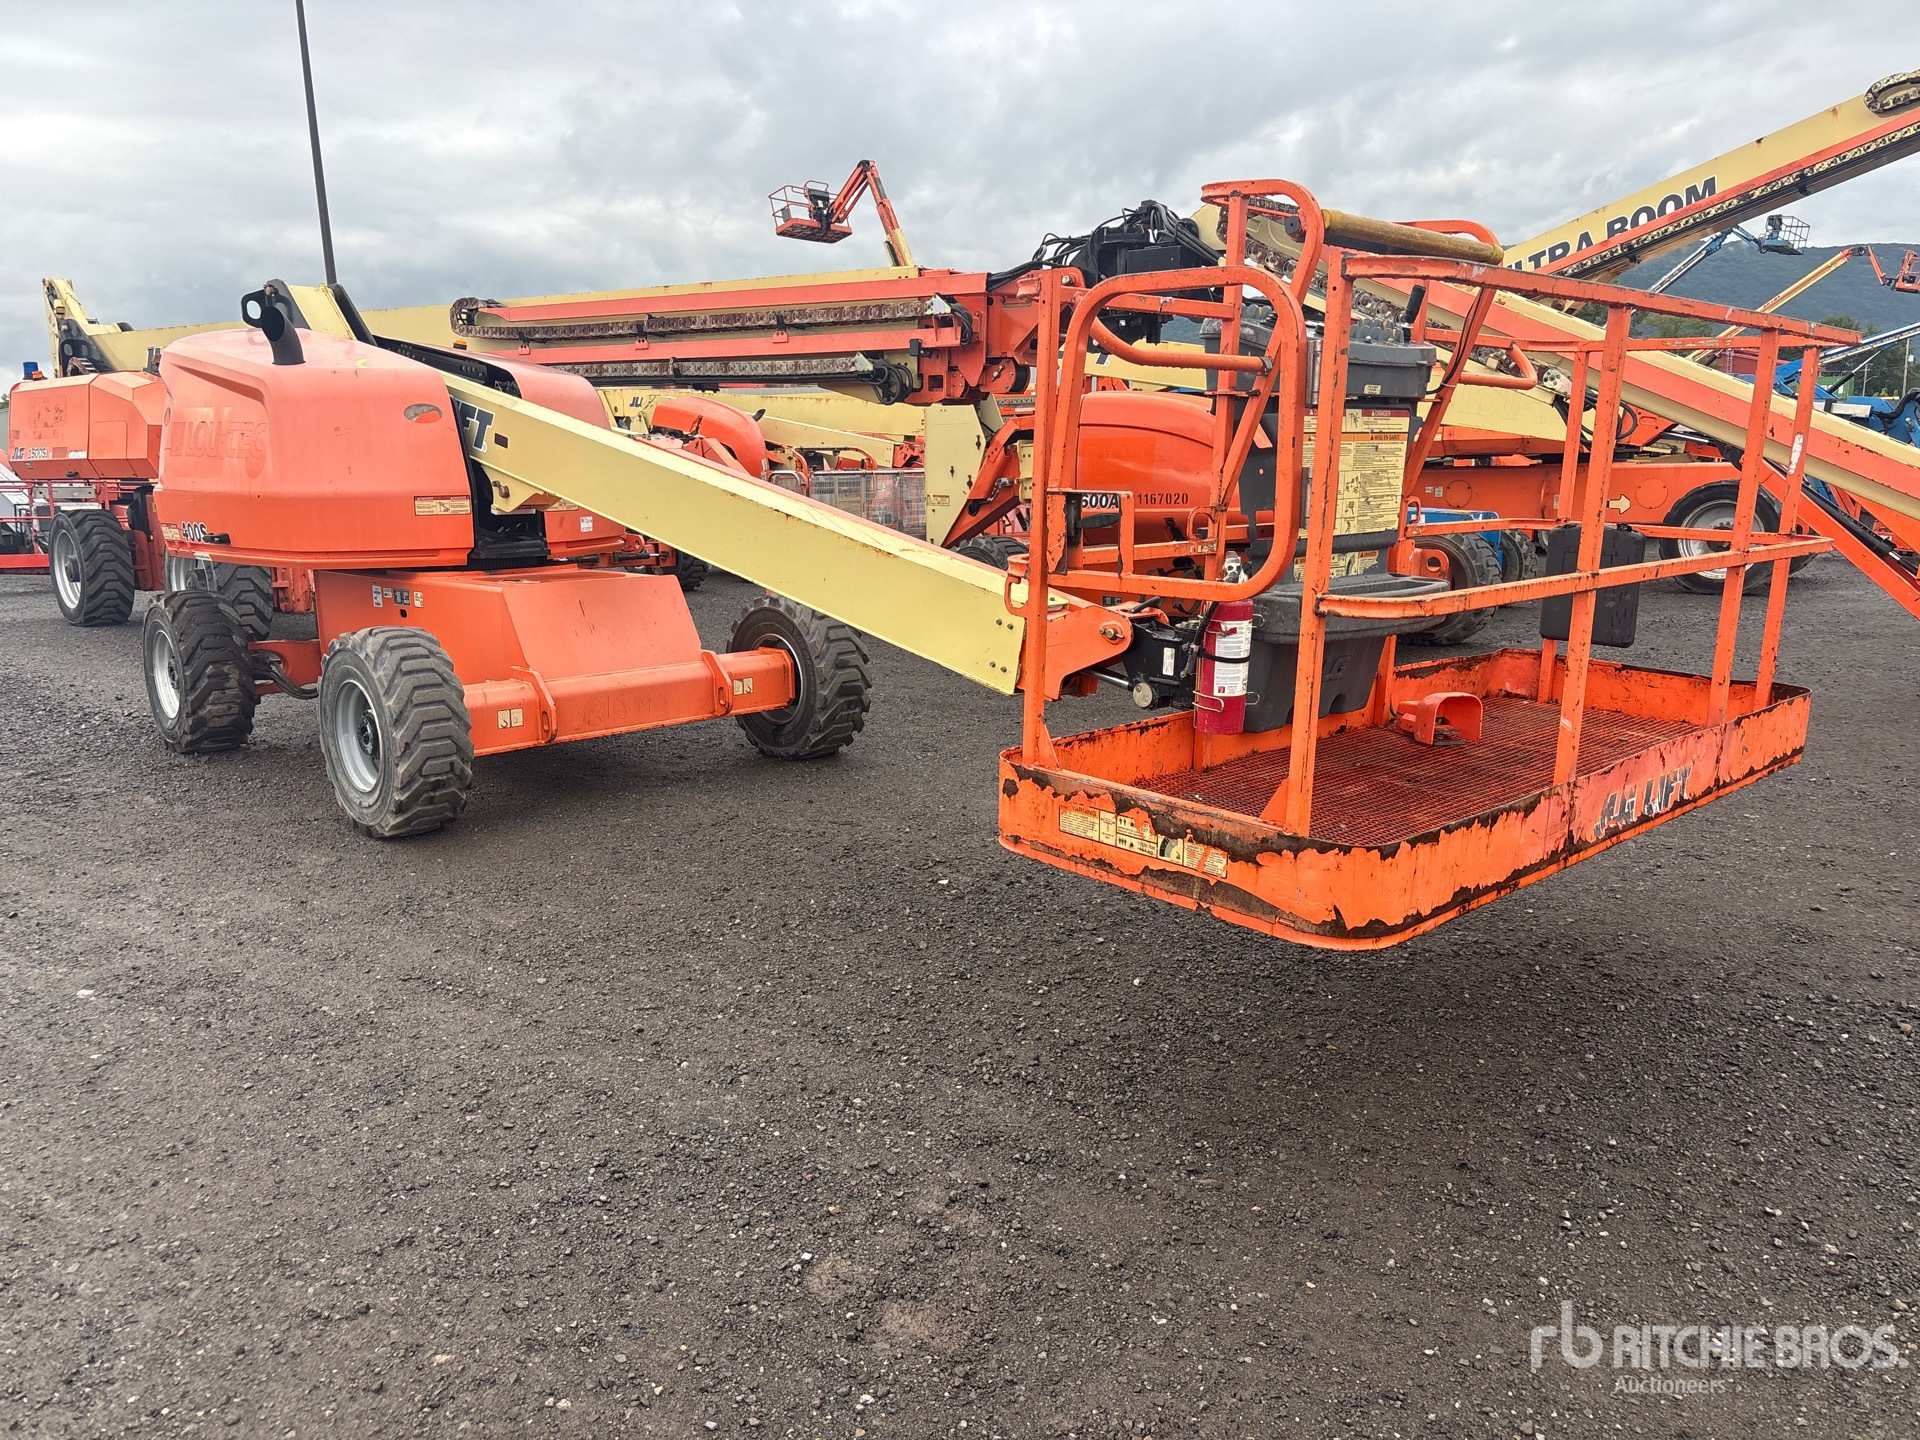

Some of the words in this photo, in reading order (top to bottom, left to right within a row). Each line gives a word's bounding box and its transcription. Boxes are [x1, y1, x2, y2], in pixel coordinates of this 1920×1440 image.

[1506, 231, 1594, 271] TRA
[1606, 175, 1717, 239] BOOM
[629, 396, 643, 408] JL
[452, 395, 495, 452] FT
[1137, 492, 1189, 505] 1167020
